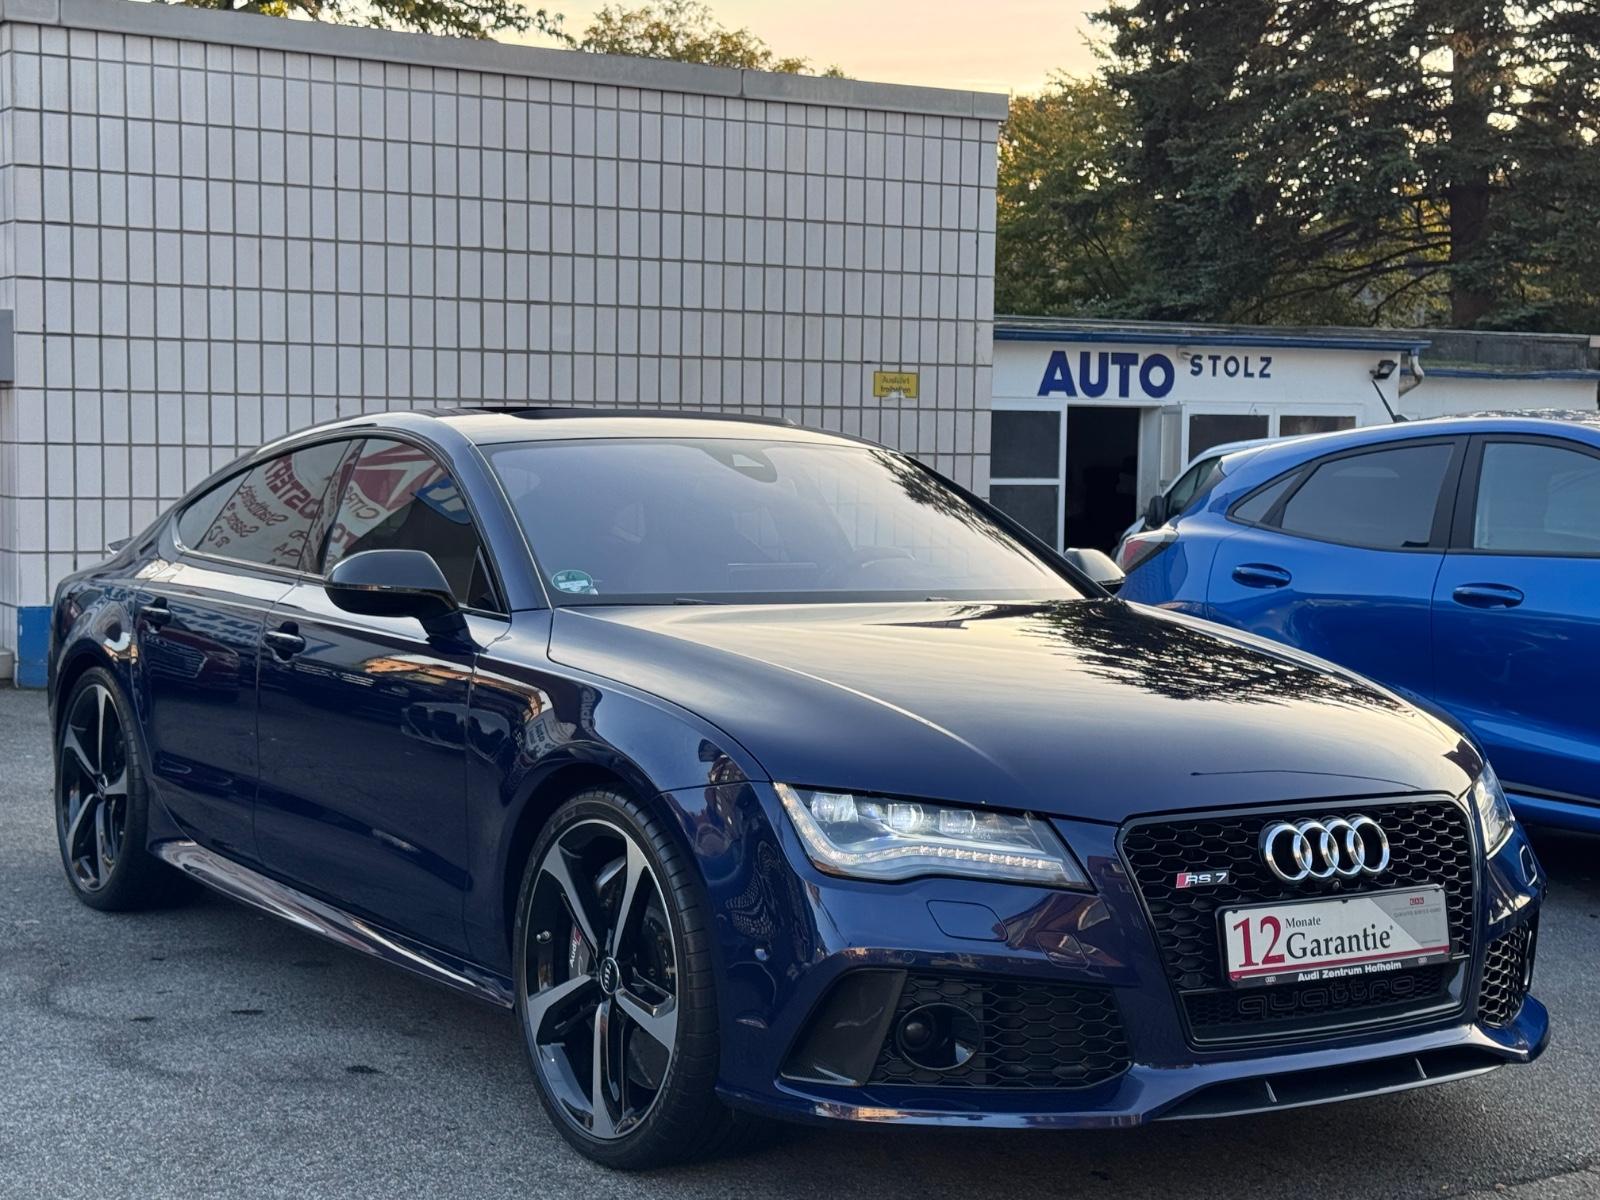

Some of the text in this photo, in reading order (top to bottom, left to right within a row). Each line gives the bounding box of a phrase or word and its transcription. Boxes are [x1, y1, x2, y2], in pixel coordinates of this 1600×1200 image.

[1037, 350, 1272, 399] AUTO STOLZ
[1184, 872, 1227, 886] RS 7
[569, 939, 577, 968] Audi
[1233, 916, 1322, 968] 12 Monate
[1298, 961, 1402, 982] Audi Zentrum Hofheim
[1238, 975, 1415, 1018] quattro
